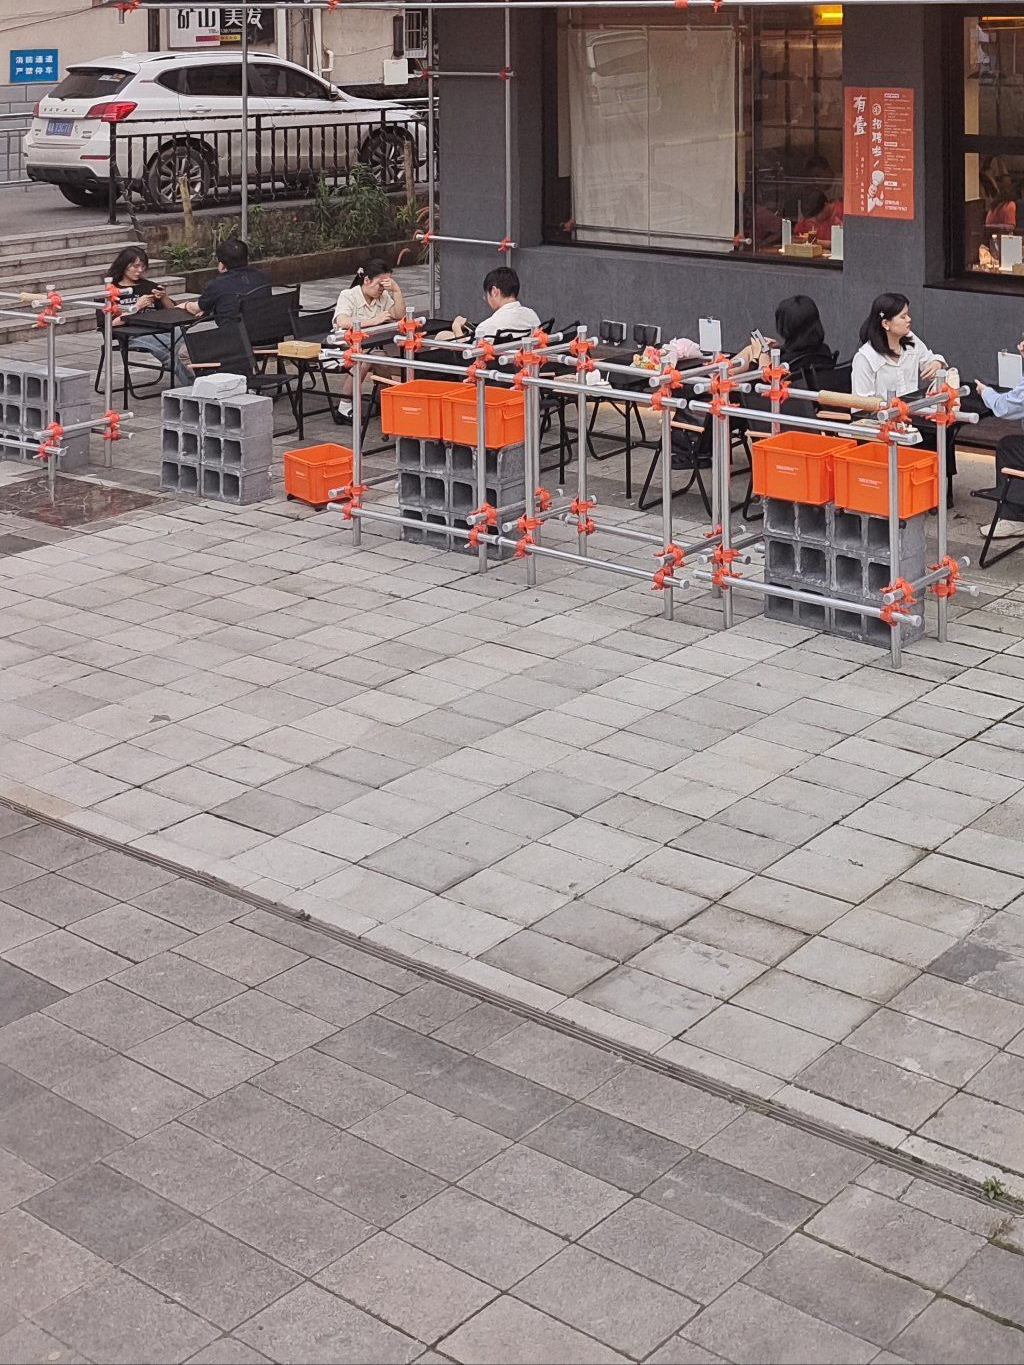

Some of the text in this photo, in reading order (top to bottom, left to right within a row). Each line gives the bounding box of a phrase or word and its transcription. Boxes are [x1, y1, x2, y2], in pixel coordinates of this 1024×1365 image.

[16, 55, 53, 64] 消防通道
[15, 67, 53, 75] 严禁停车
[853, 95, 867, 136] 有壹
